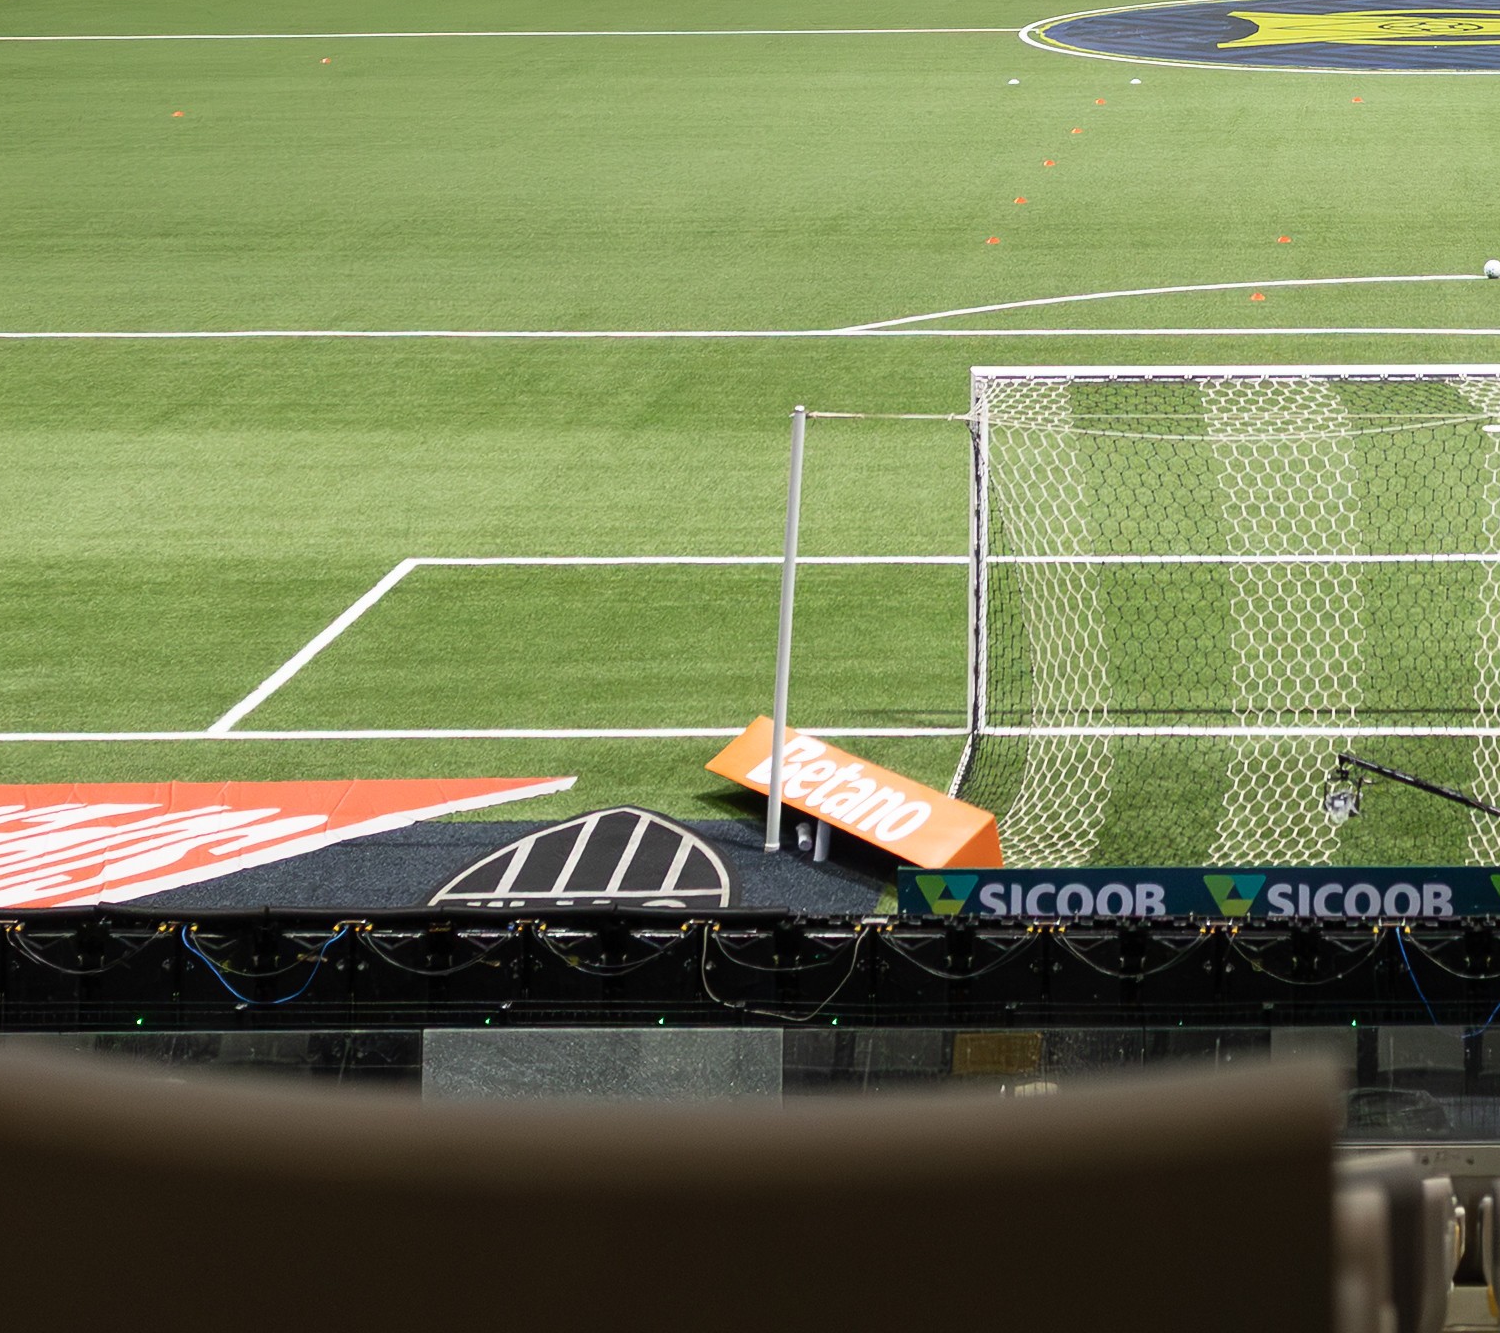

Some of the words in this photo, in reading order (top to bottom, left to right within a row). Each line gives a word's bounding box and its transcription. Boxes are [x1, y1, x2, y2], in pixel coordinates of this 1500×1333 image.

[747, 734, 933, 843] Betano
[979, 881, 1165, 918] SICOOB
[1266, 881, 1453, 918] SICOOB
